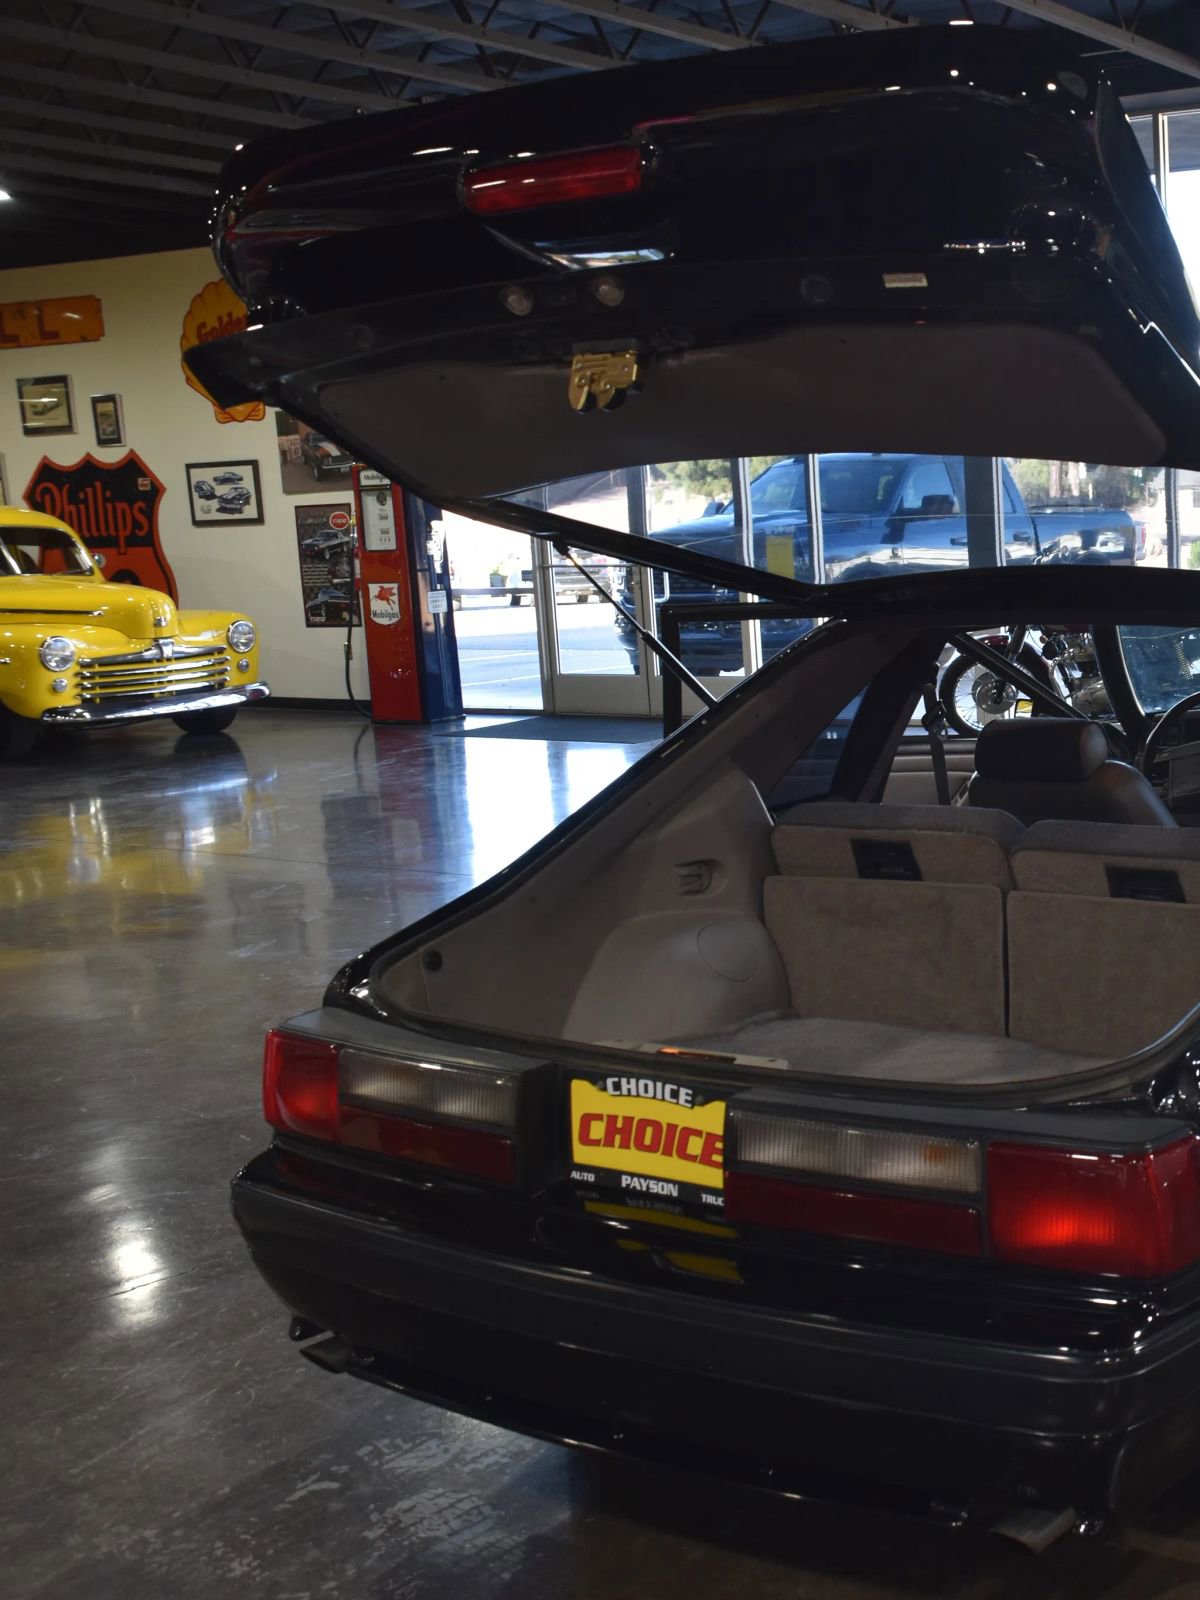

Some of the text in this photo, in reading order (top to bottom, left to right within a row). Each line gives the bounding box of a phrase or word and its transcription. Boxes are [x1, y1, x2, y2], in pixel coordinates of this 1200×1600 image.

[35, 481, 149, 555] Phillips
[372, 610, 400, 621] Mobilgas
[606, 1077, 693, 1108] CHOICE
[578, 1112, 725, 1169] CHOICE
[570, 1171, 595, 1182] AUTO
[621, 1174, 678, 1197] PAYSON
